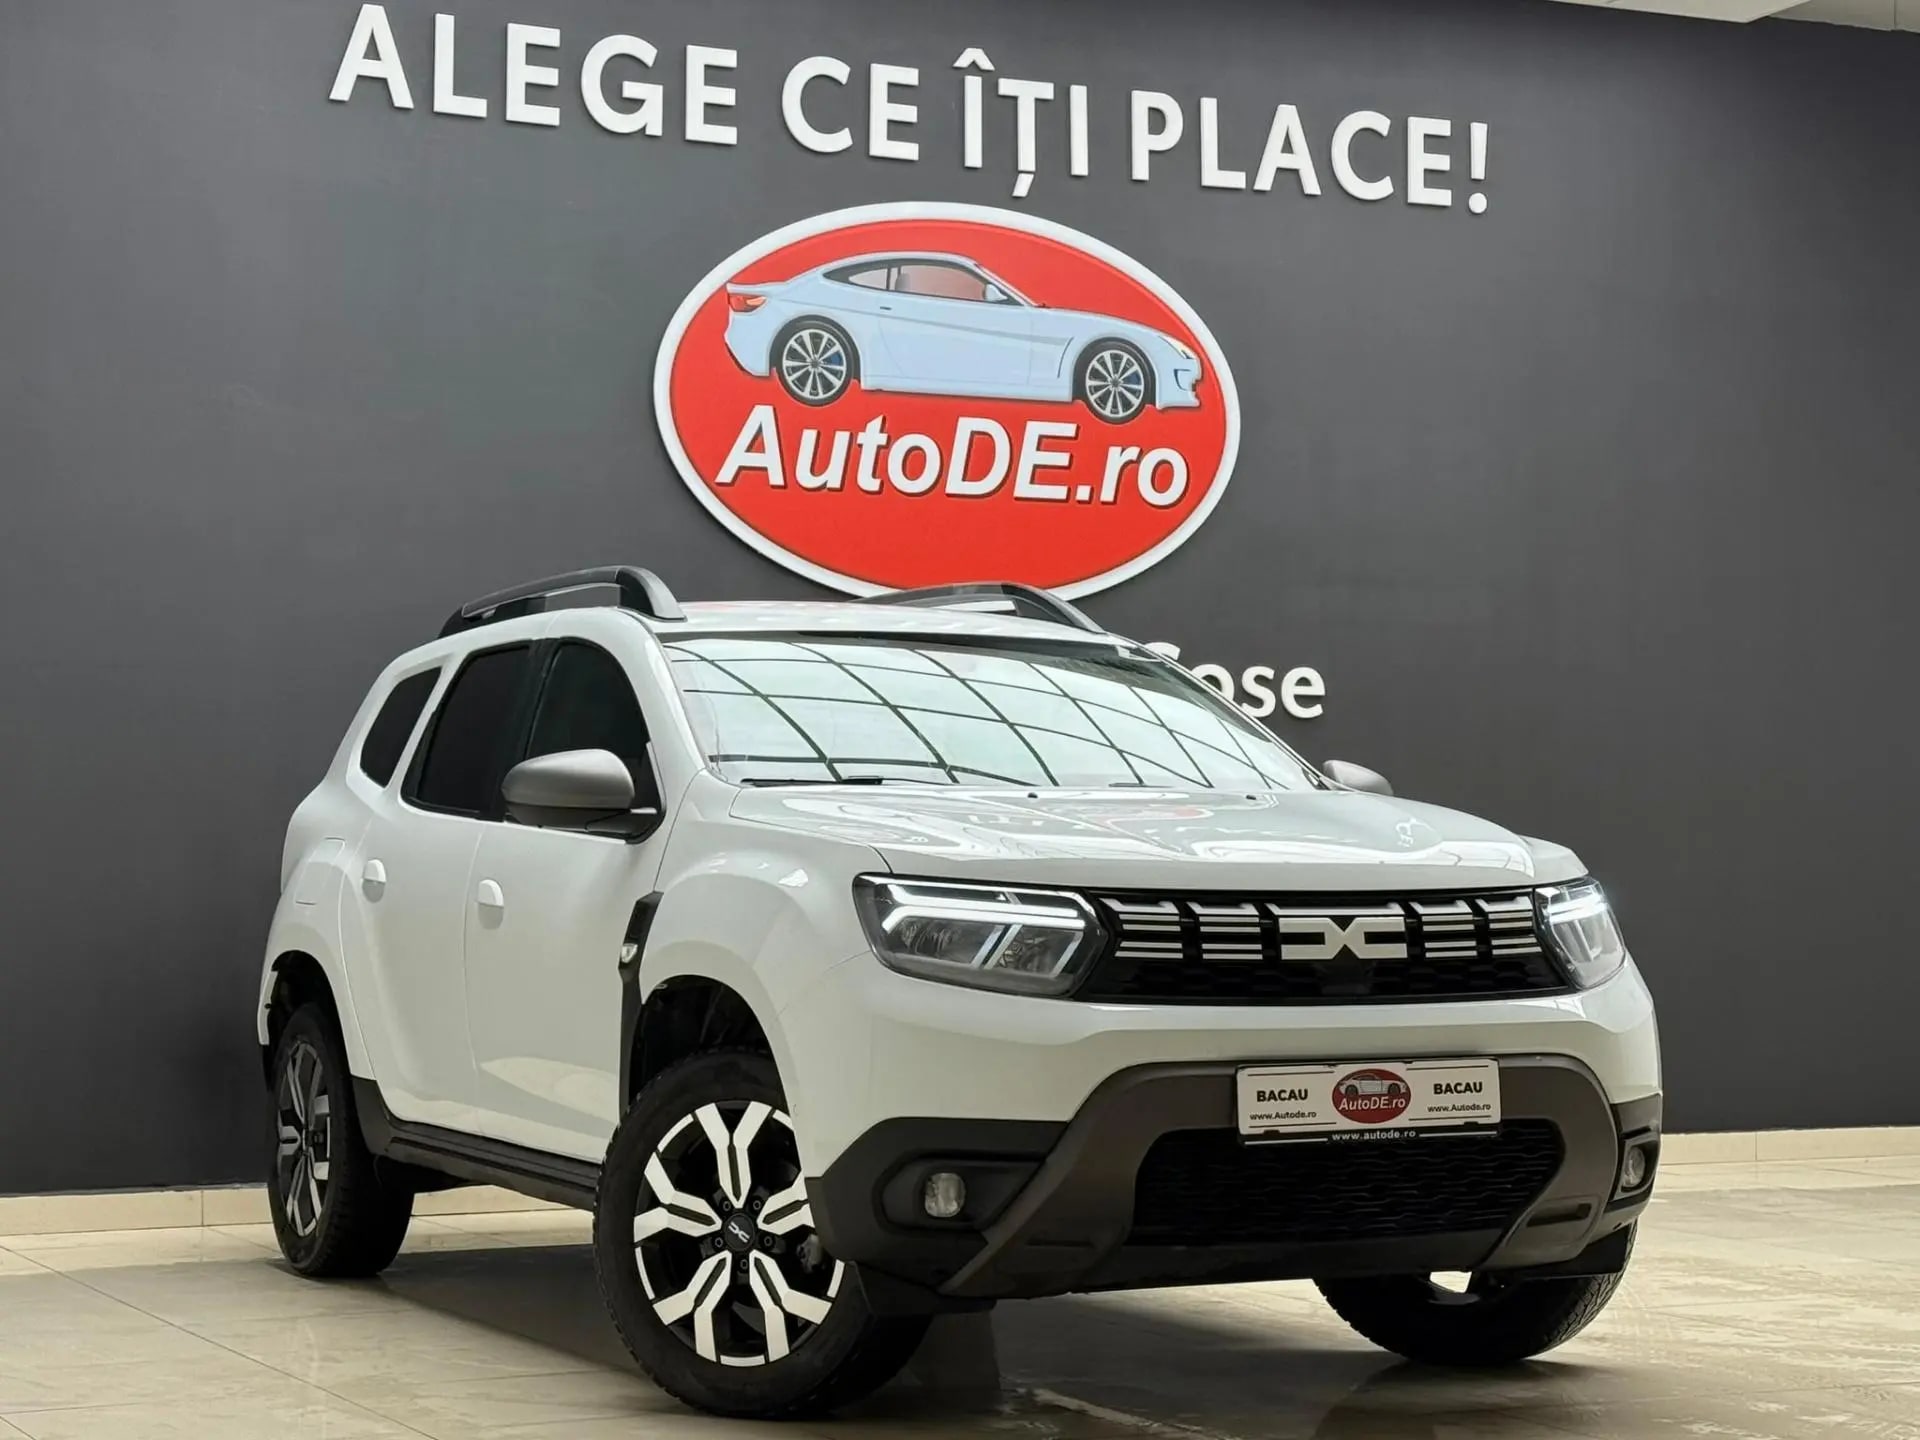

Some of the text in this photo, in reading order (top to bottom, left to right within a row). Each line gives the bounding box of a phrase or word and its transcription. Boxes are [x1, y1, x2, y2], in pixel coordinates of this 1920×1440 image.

[329, 2, 738, 146] ALEGE
[781, 55, 920, 161] CE
[1130, 89, 1489, 215] PLACE!
[715, 404, 1191, 509] AutoDE.ro
[1256, 1088, 1309, 1102] BACAU
[1433, 1081, 1483, 1095] BACAU
[1338, 1096, 1406, 1111] AutoDE.ro
[1249, 1109, 1317, 1120] www.Autode.ro
[1331, 1129, 1417, 1142] www.autode.ro
